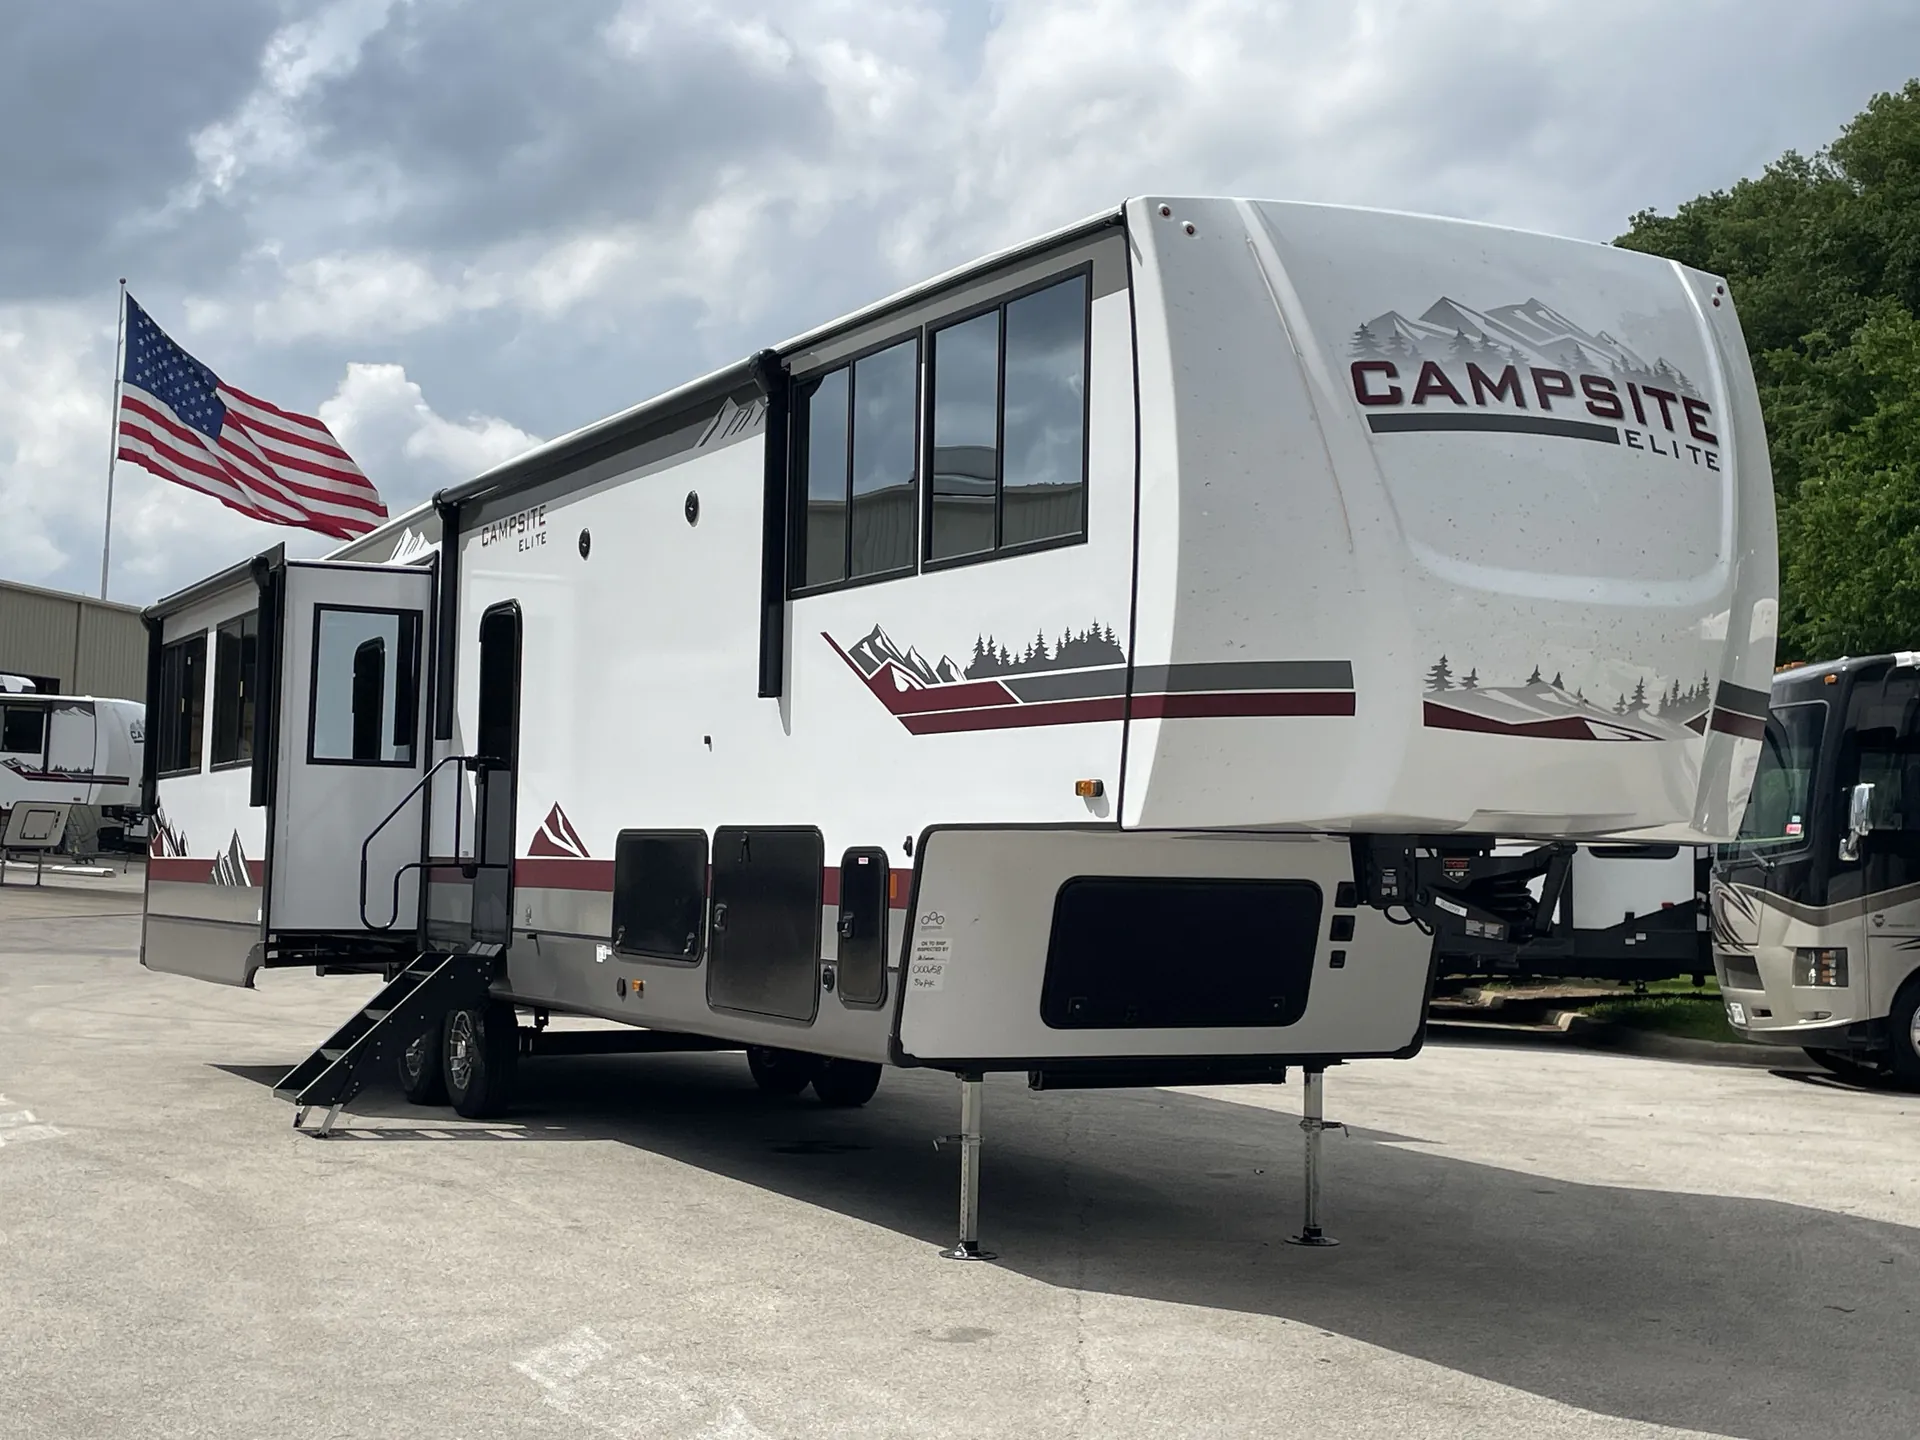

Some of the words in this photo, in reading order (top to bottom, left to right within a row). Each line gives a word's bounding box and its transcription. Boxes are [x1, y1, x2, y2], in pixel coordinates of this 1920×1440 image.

[1350, 361, 1718, 446] CAMPSITE
[1627, 430, 1720, 472] ELITE
[482, 505, 547, 547] CAMPSITE
[519, 532, 547, 552] ELITE
